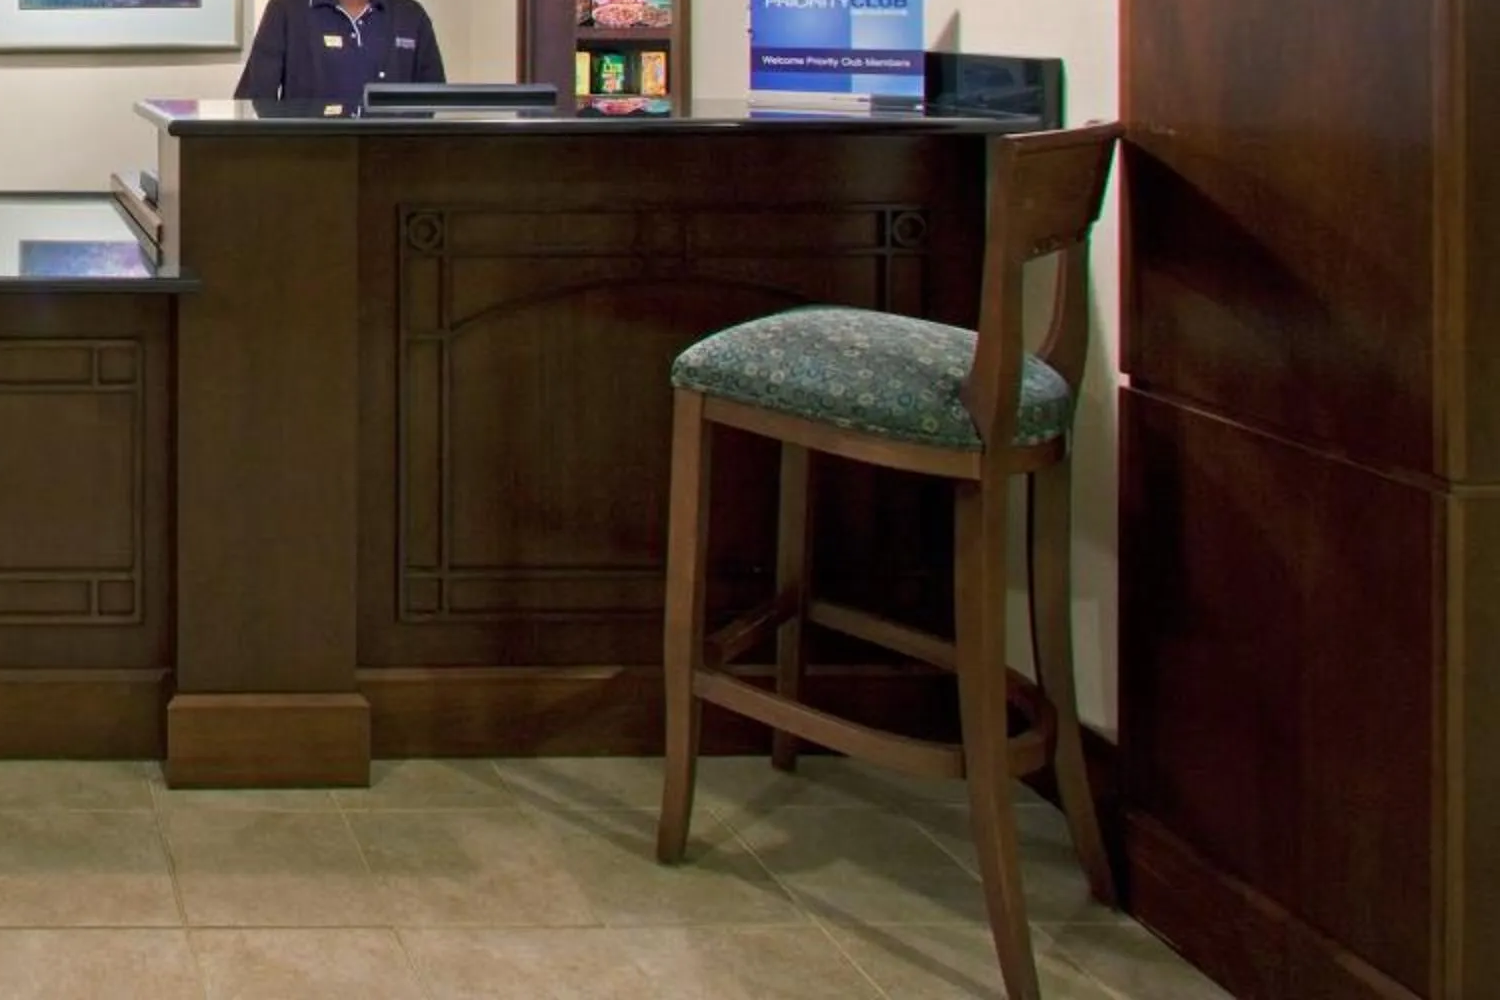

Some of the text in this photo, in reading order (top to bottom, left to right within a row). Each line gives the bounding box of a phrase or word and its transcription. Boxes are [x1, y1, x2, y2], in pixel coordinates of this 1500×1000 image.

[761, 55, 912, 69] Welcome Priority Club Members
